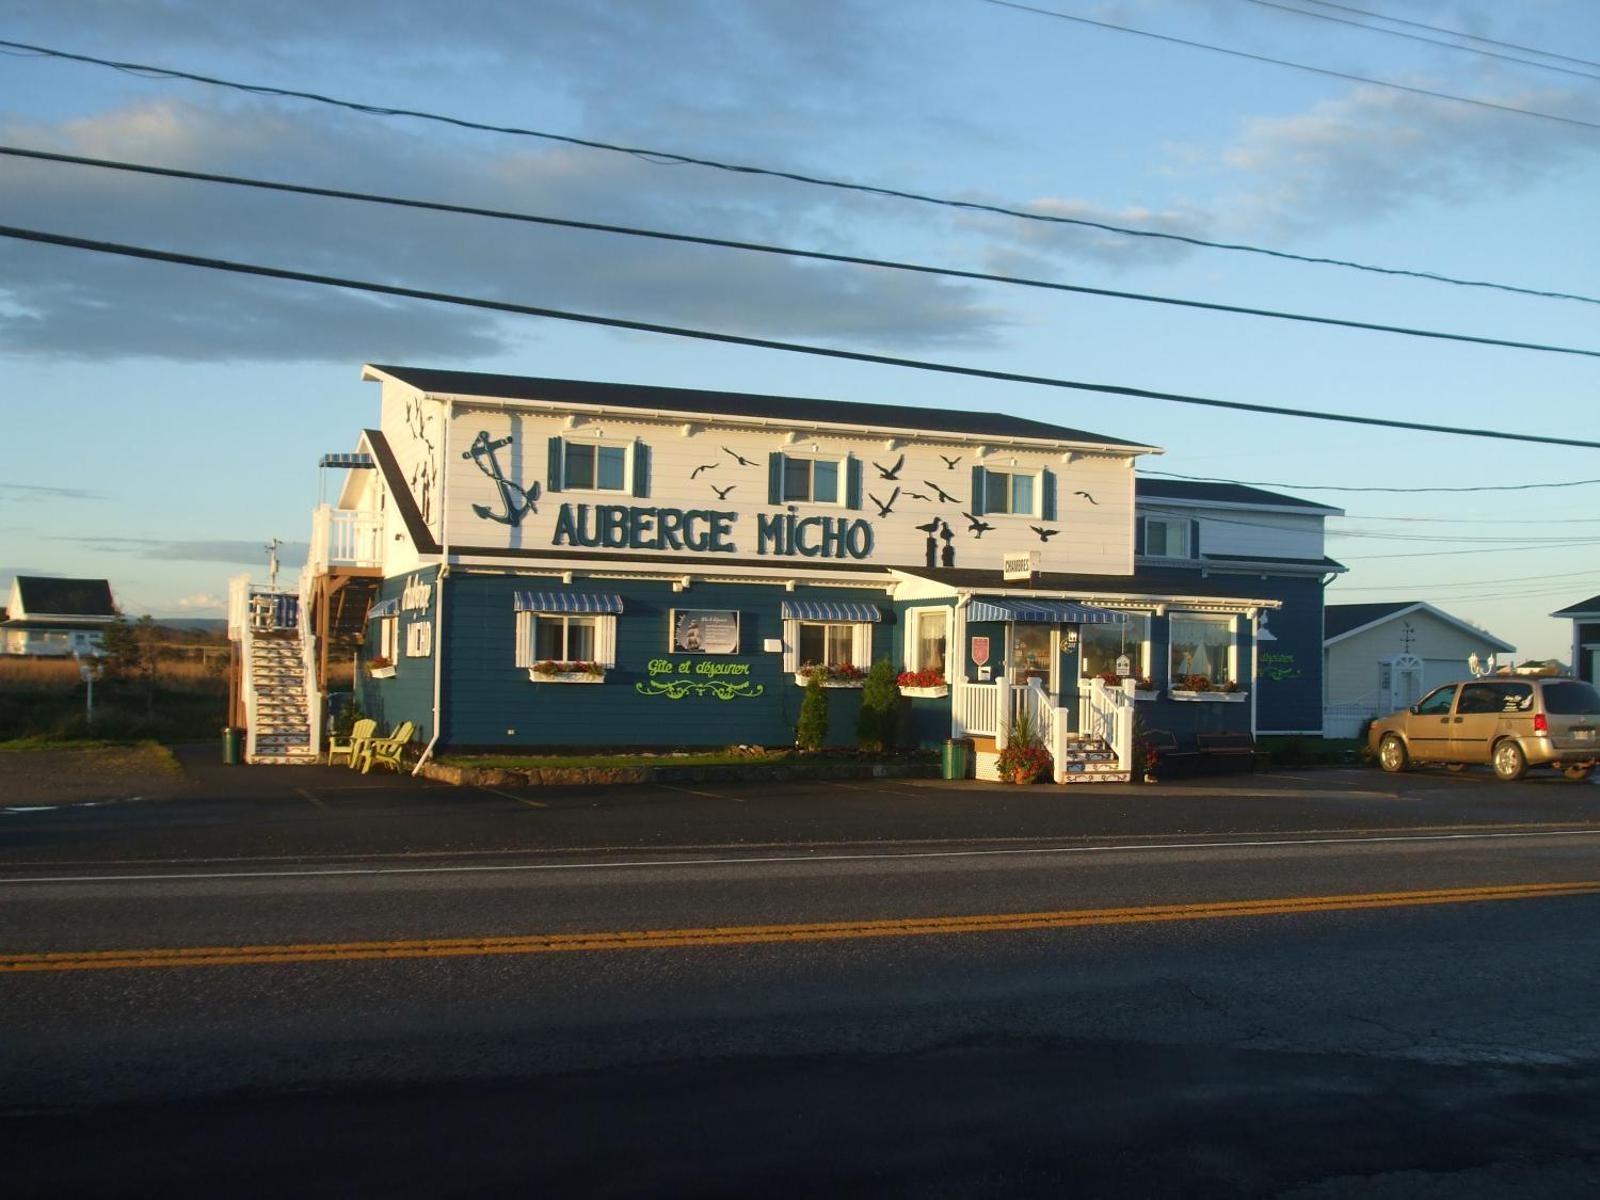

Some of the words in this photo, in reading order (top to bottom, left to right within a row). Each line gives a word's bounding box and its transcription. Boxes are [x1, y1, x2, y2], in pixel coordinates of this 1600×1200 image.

[552, 502, 738, 552] AUBERGE
[1005, 558, 1029, 573] CHAMBRES
[648, 659, 673, 676] Gîte
[678, 661, 691, 674] et
[696, 661, 749, 677] déjeuner
